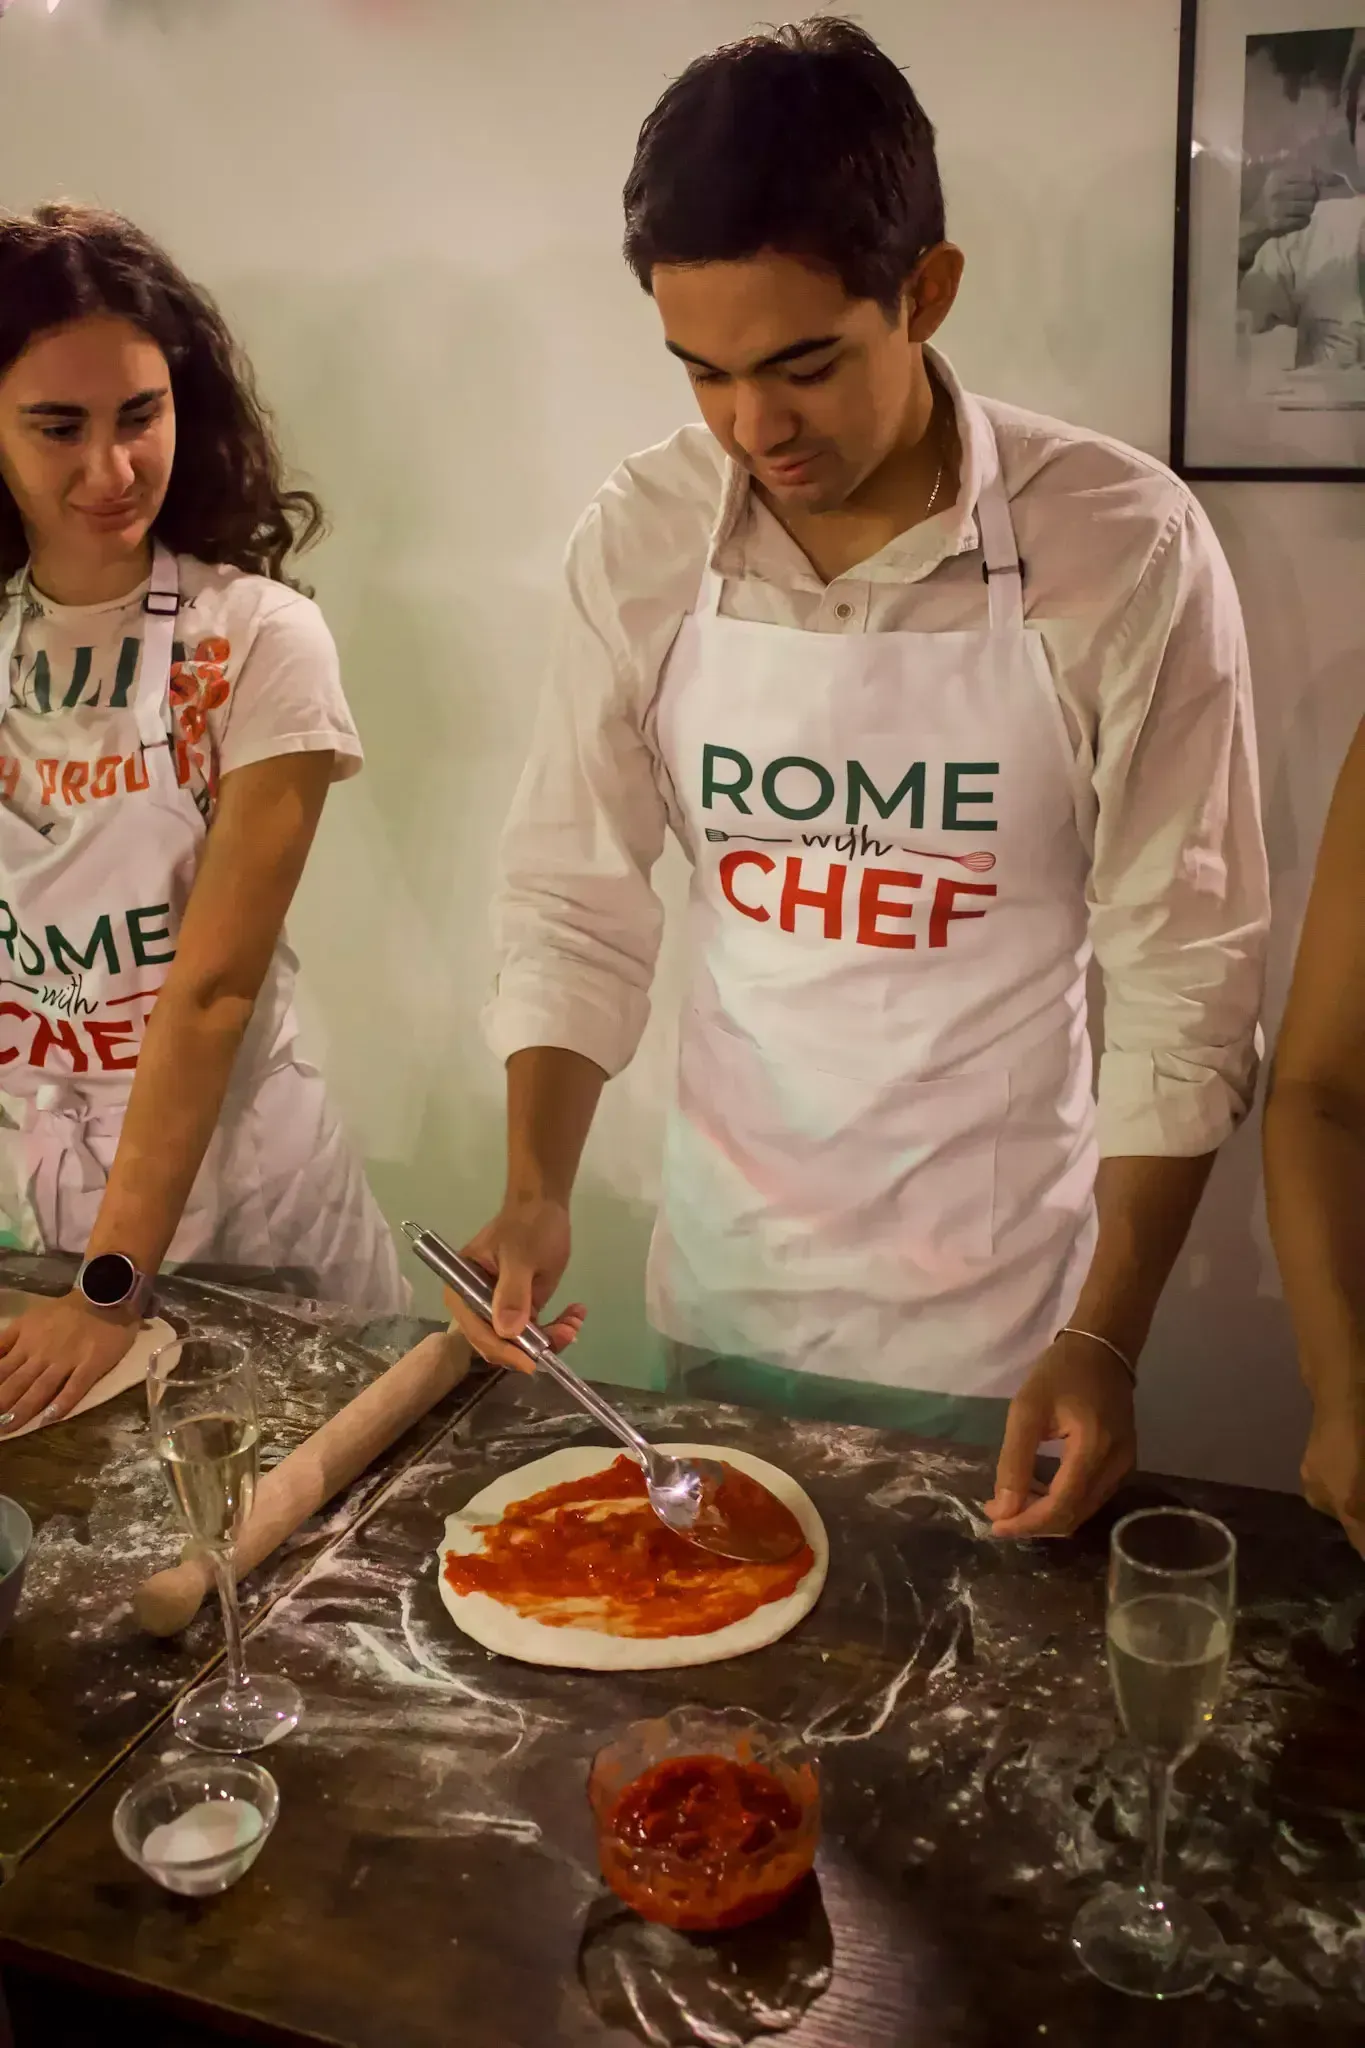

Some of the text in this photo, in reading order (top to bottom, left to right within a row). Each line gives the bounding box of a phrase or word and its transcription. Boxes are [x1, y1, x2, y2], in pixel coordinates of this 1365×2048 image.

[702, 743, 999, 831] ROME
[801, 824, 893, 860] with
[719, 850, 997, 949] CHEF
[41, 973, 98, 1018] with
[0, 1001, 150, 1072] CHE
